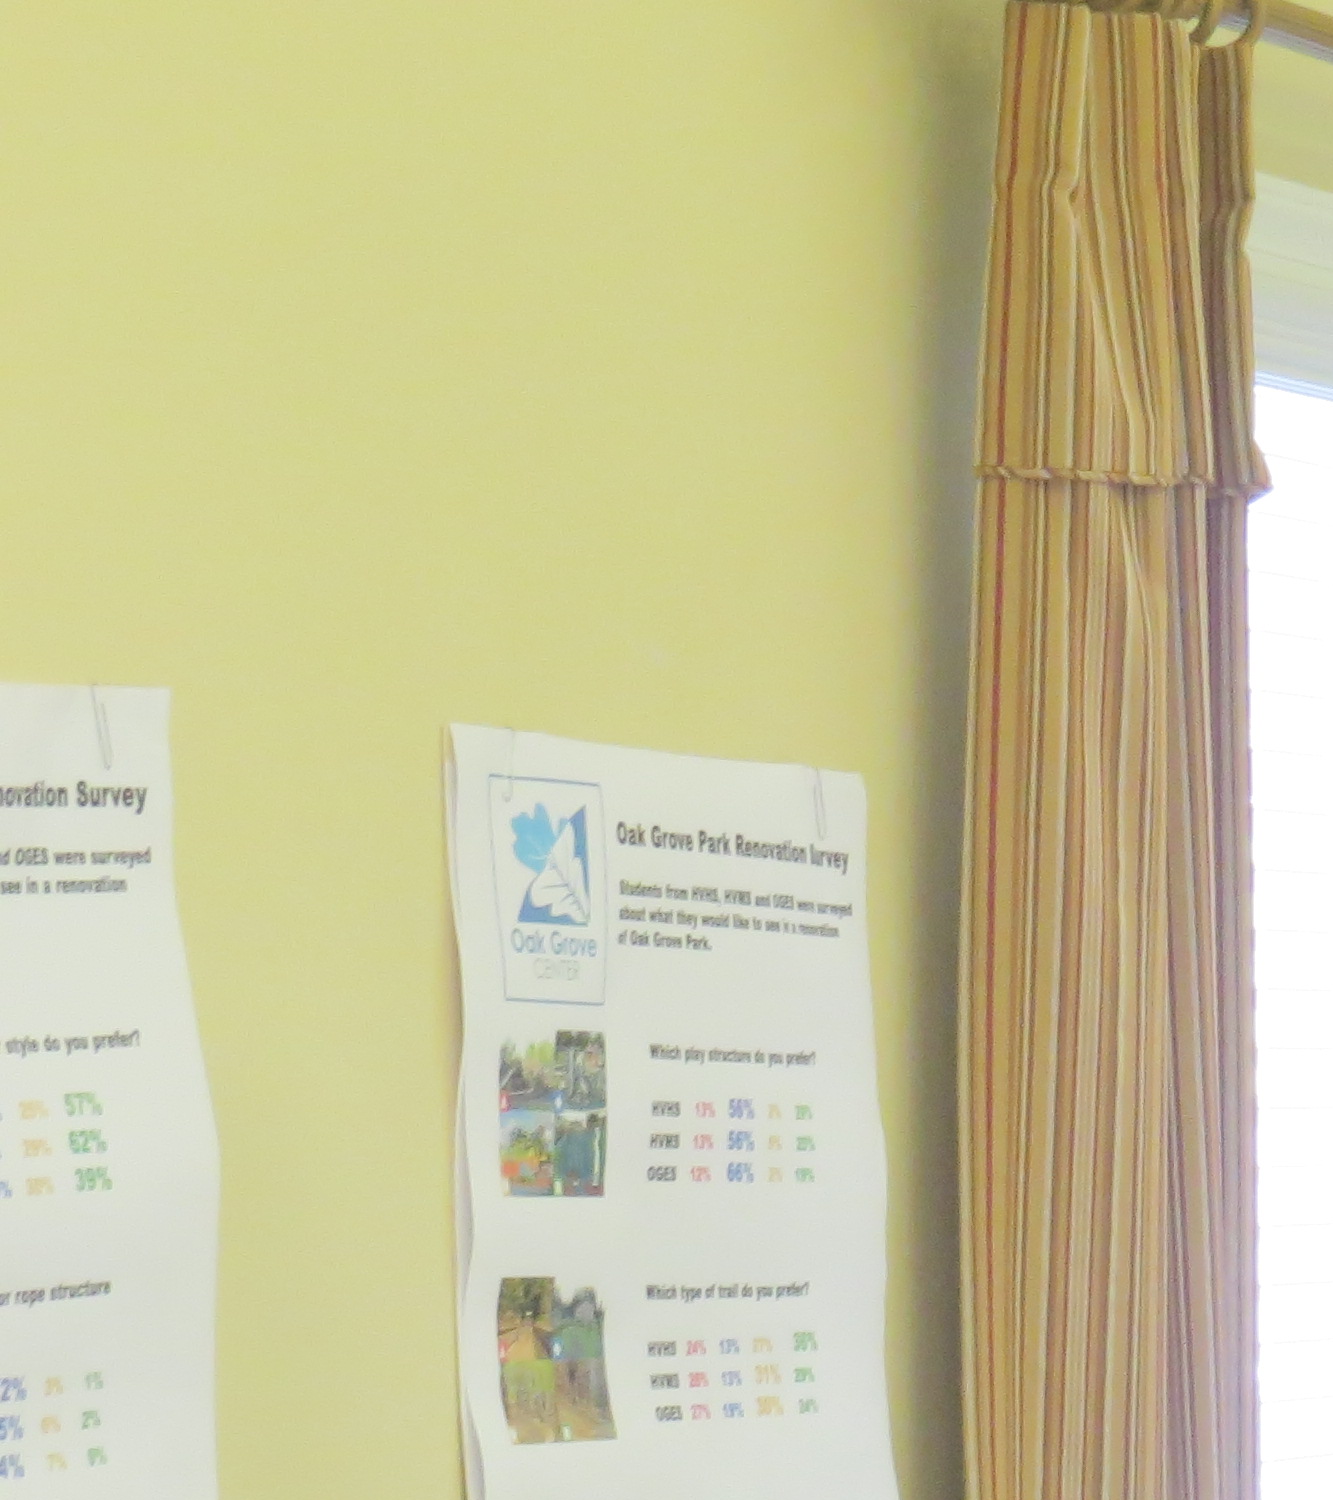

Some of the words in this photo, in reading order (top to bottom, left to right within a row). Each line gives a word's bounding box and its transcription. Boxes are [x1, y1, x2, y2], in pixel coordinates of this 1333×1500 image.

[76, 780, 147, 815] Survey
[511, 928, 545, 953] Oak
[549, 931, 597, 959] Grove
